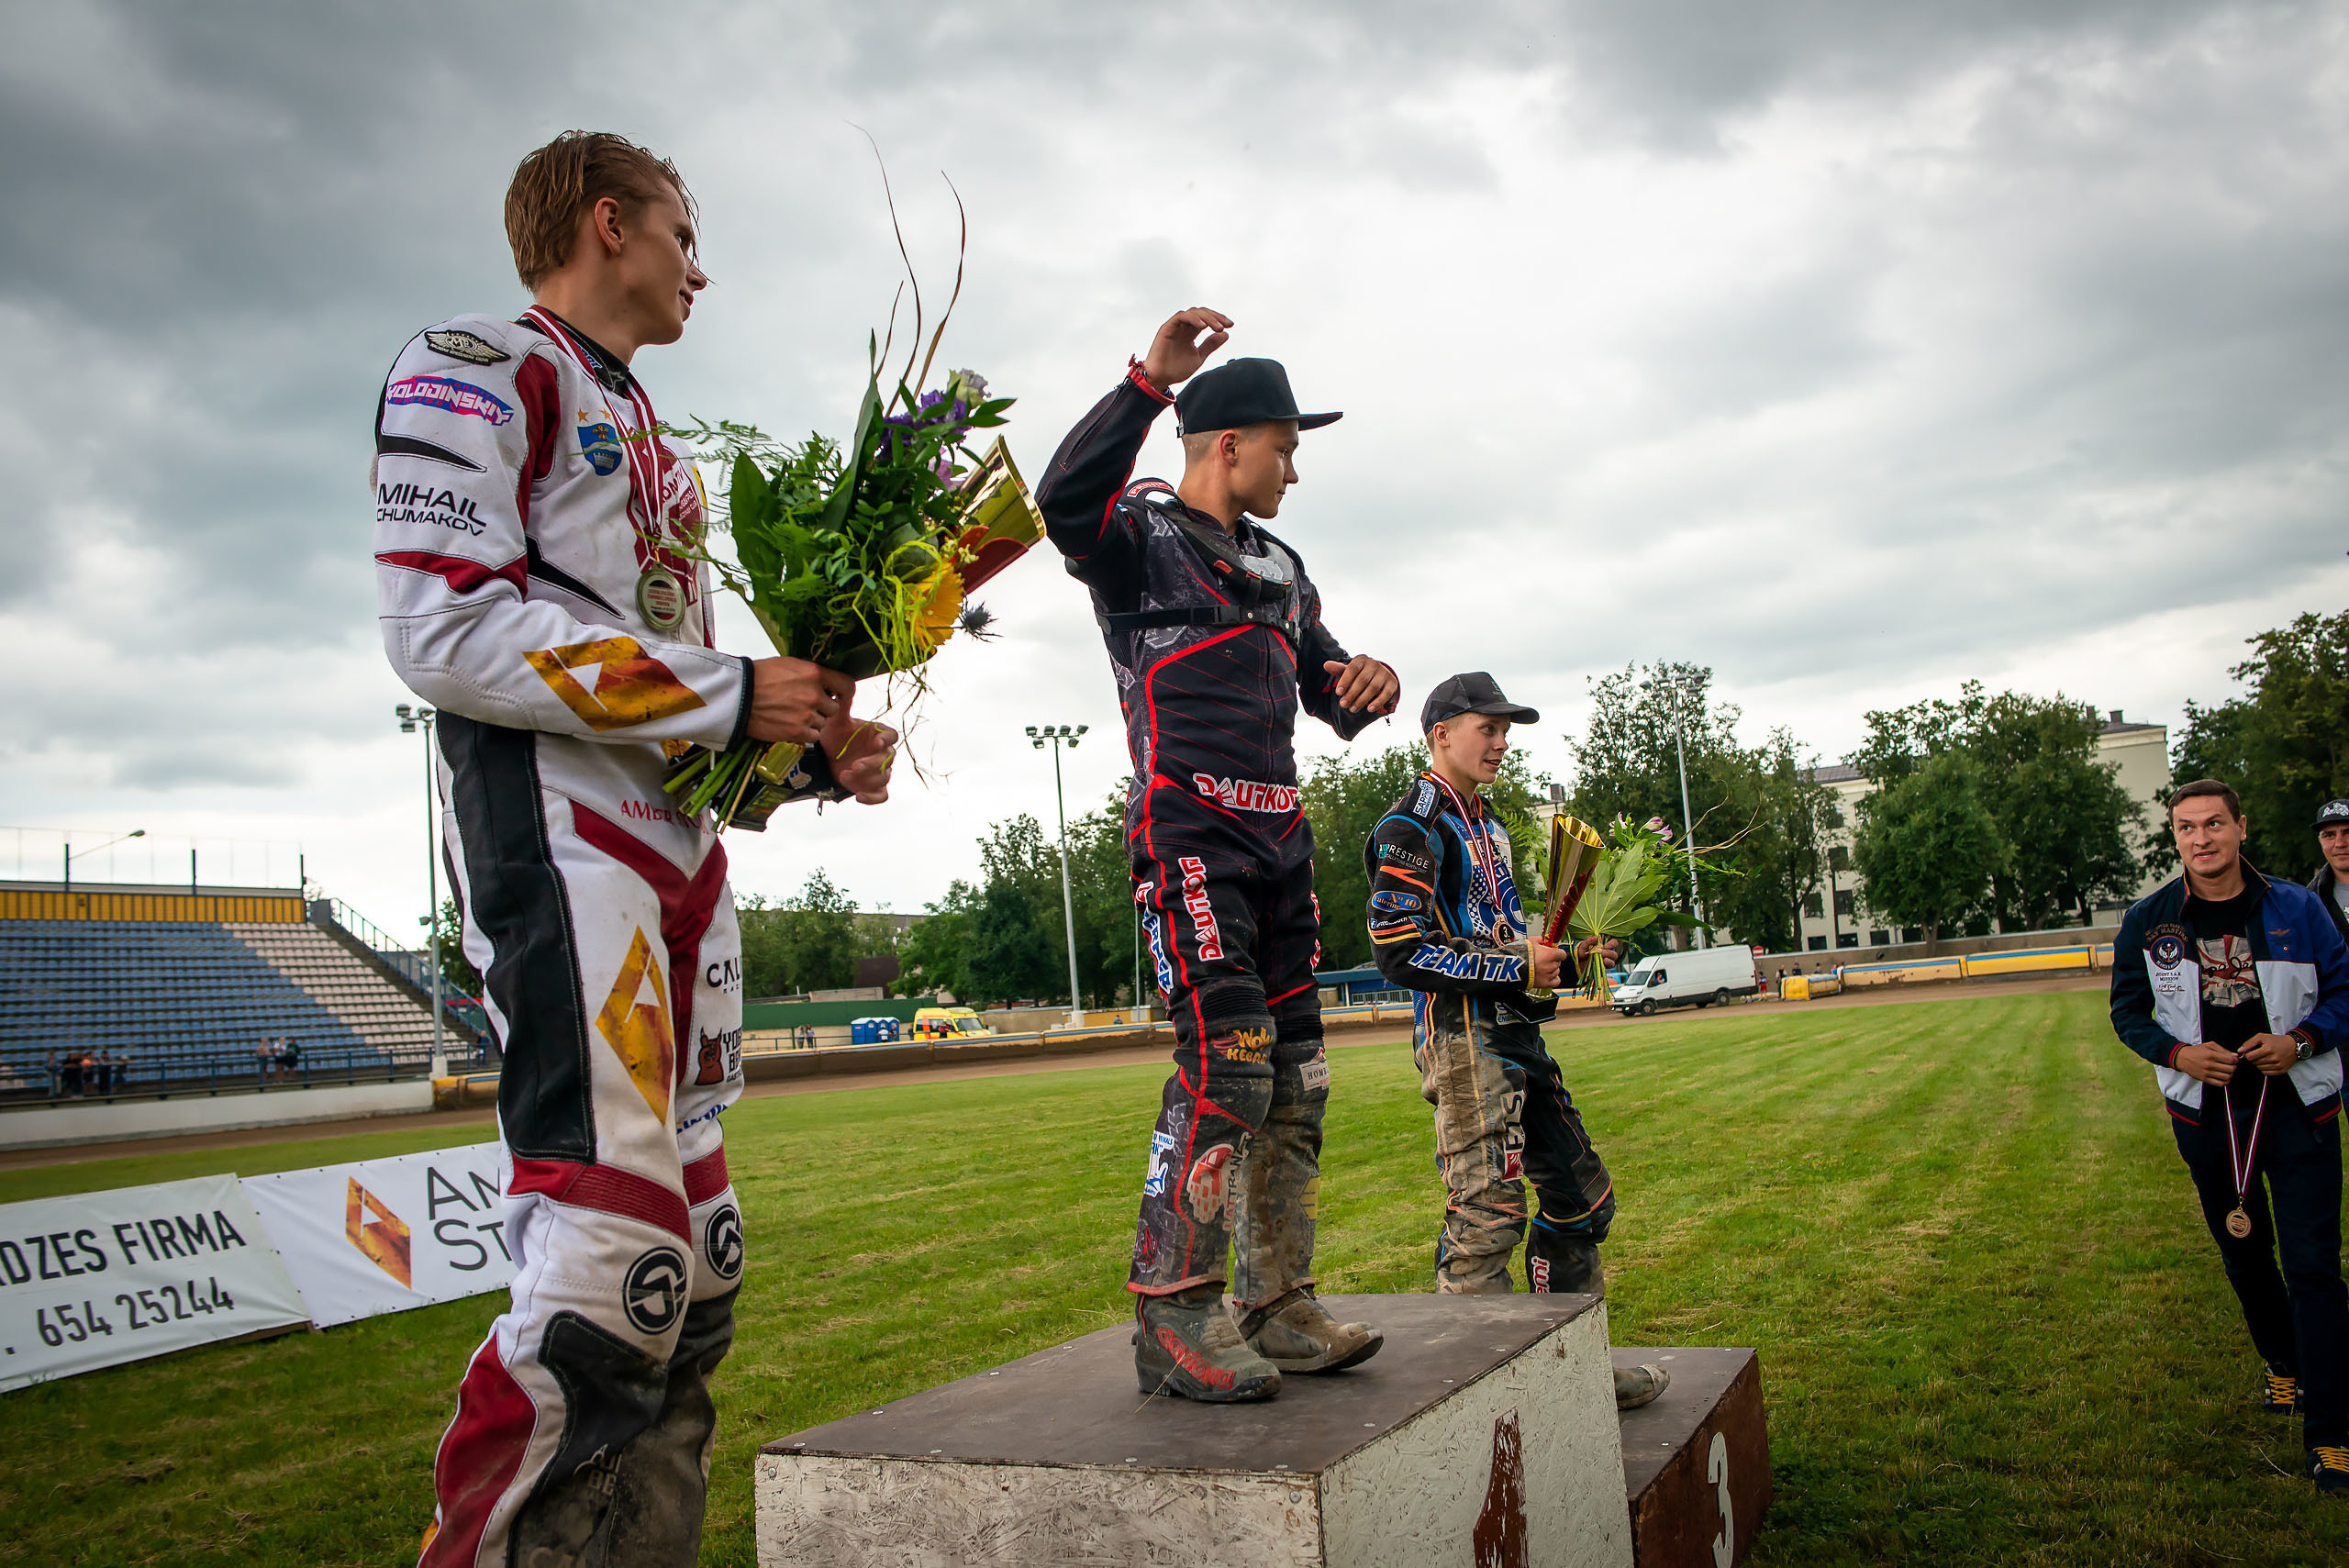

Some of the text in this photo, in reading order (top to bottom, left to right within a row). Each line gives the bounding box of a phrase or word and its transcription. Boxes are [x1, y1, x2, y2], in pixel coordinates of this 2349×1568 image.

[376, 507, 484, 537] CHUMAKOV
[377, 483, 487, 528] MIHAIL
[1404, 898, 1417, 908] 10
[1408, 943, 1526, 982] TEAM TK
[0, 1209, 248, 1286] DZES FIRMA
[433, 1218, 512, 1271] ST
[37, 1276, 235, 1347] 654 25244
[1708, 1431, 1734, 1568] 3
